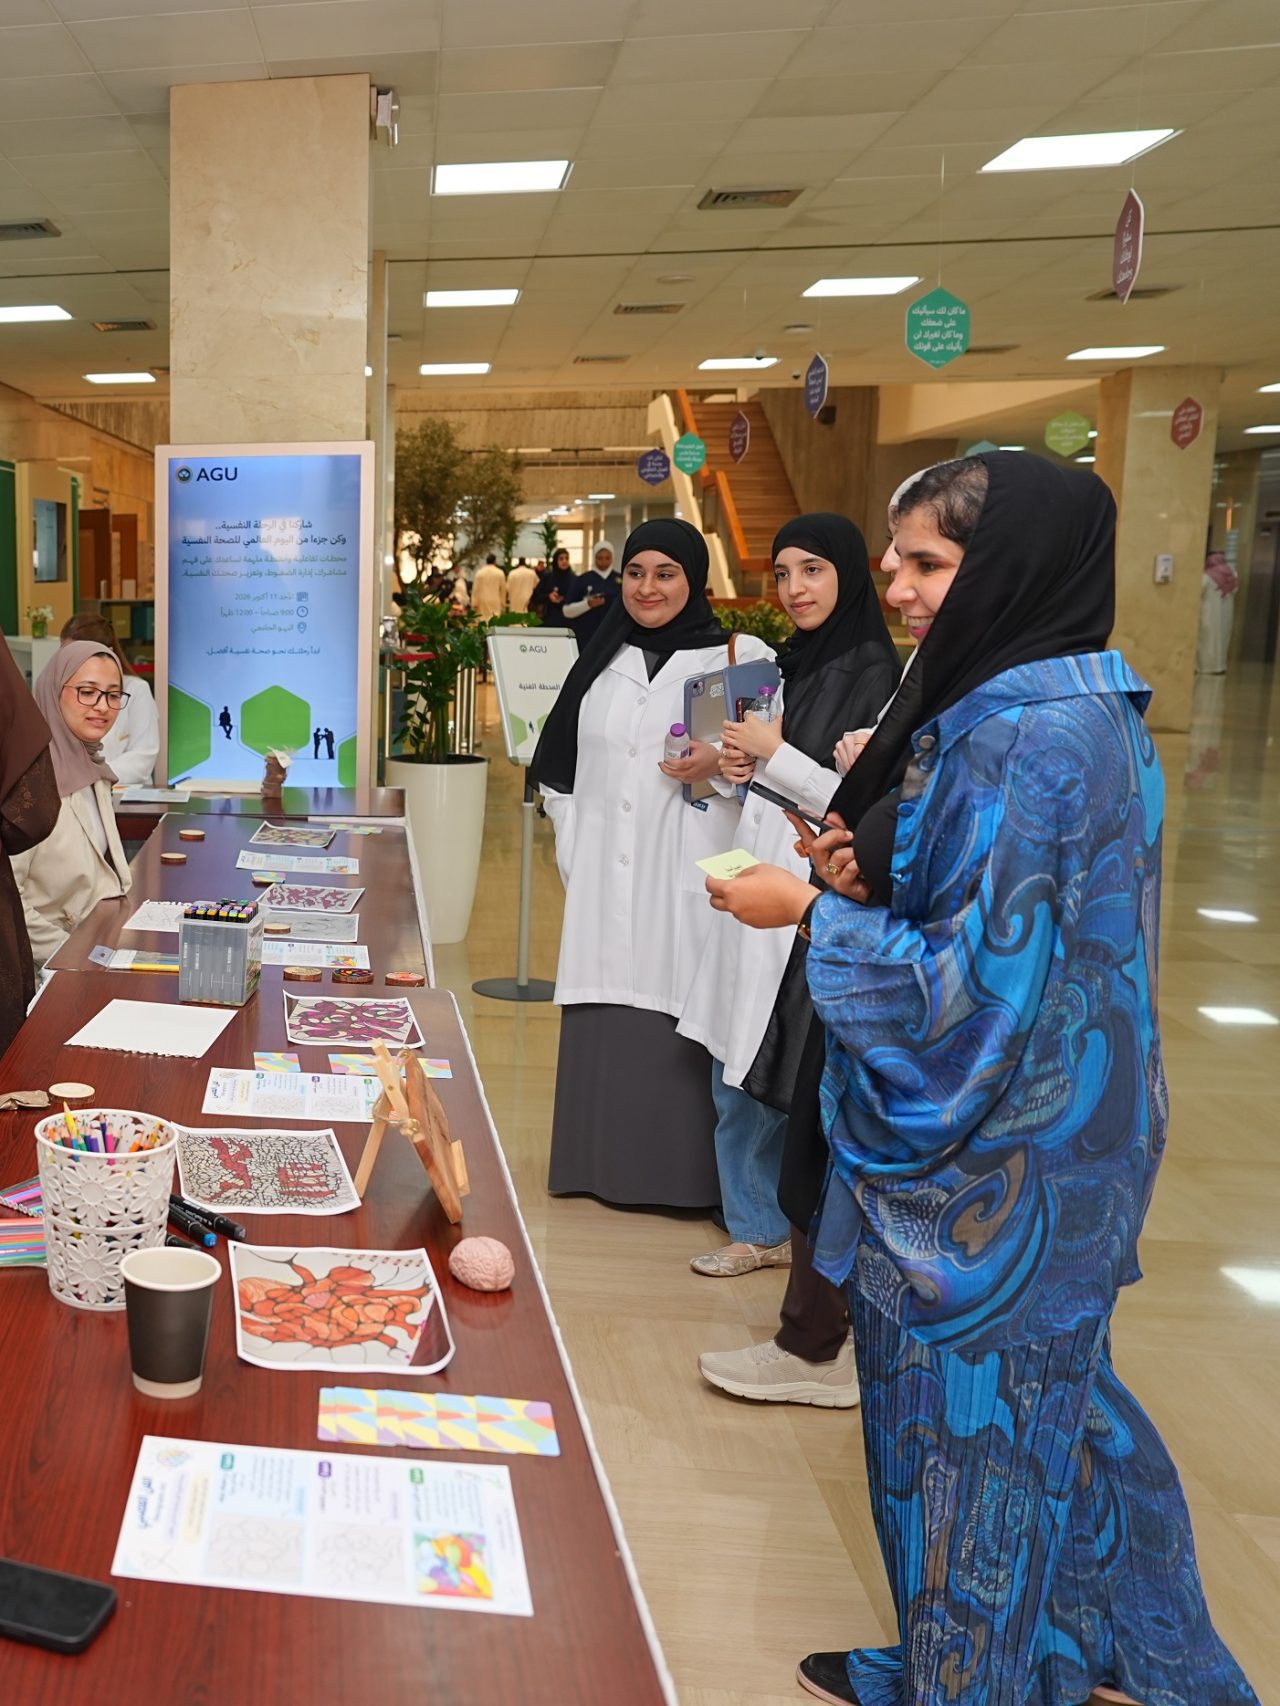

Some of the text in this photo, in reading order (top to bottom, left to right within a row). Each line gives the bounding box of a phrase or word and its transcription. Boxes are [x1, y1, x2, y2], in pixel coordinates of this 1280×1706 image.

[196, 467, 238, 481] AGU
[253, 520, 277, 530] الرحلة
[278, 520, 287, 532] في
[288, 520, 313, 530] شاركنا
[182, 535, 212, 547] النفسية
[213, 535, 241, 545] للصحة
[242, 535, 272, 547] العالمي
[273, 535, 294, 546] اليوم
[296, 536, 309, 545] من
[329, 534, 347, 545] وكن
[529, 645, 548, 653] AGU
[519, 683, 537, 691] الفنية
